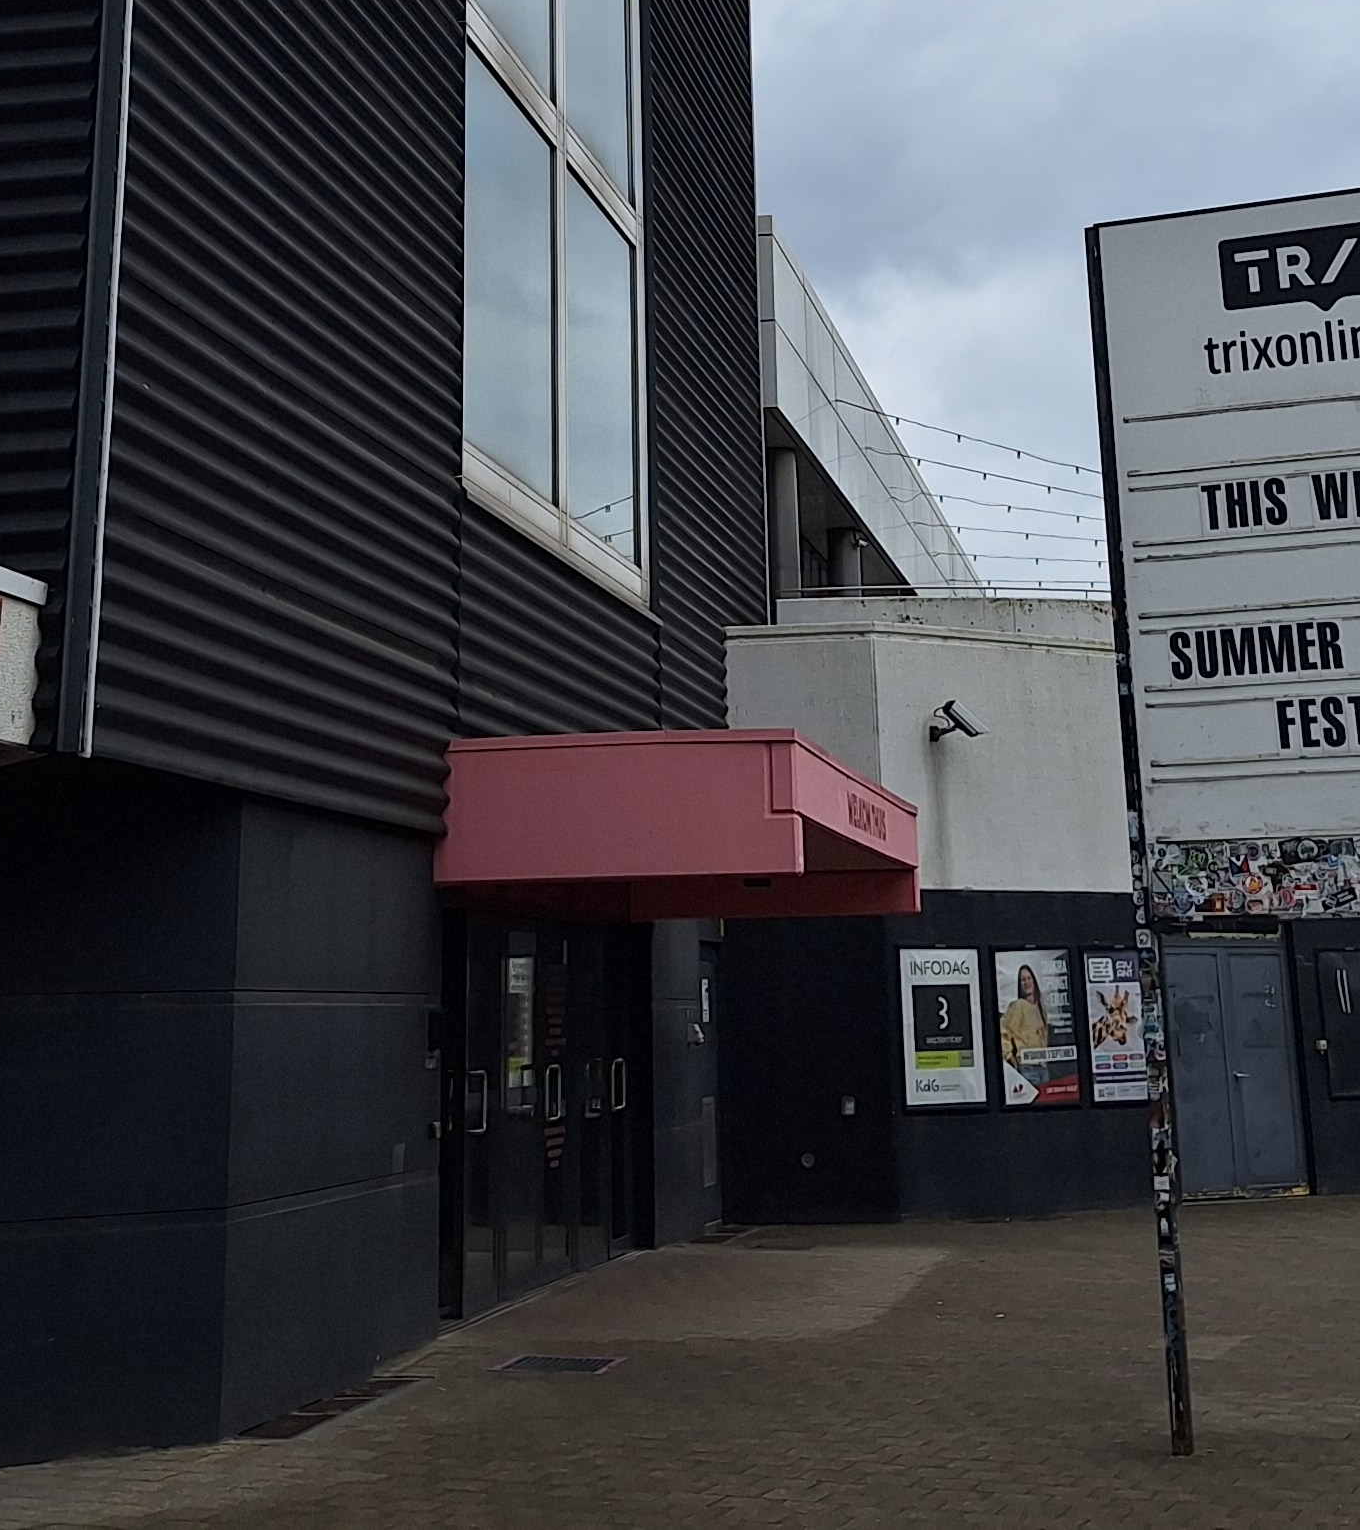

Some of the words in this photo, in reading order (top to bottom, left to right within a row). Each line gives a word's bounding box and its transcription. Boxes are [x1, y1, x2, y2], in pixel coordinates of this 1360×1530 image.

[1200, 476, 1289, 530] THIS
[1169, 620, 1344, 681] SUMMER
[910, 960, 970, 976] INFODAG
[937, 996, 949, 1031] 3
[915, 1078, 940, 1093] KdG
